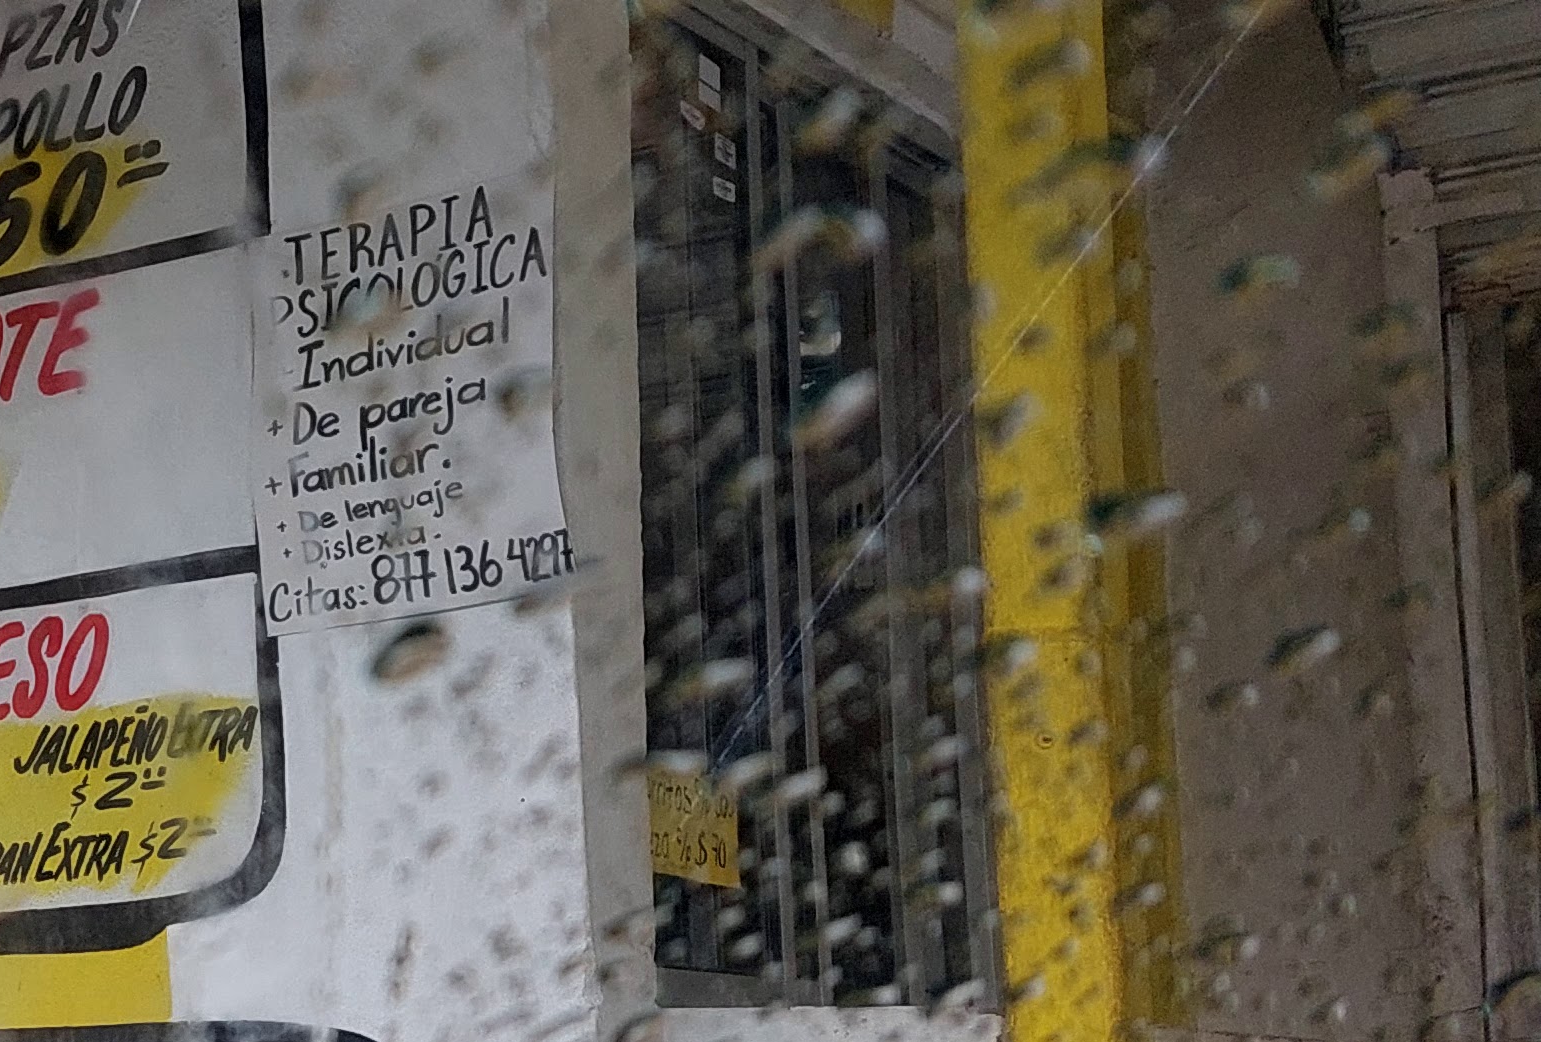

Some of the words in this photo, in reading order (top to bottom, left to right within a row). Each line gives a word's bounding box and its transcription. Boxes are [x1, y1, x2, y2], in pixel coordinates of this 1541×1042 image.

[284, 186, 493, 285] TERAPIA
[294, 296, 509, 391] Individual
[293, 402, 340, 446] De
[360, 377, 486, 451] pareja
[298, 510, 338, 532] De
[345, 480, 463, 528] lenguaje
[300, 526, 441, 564] Dislexa.
[269, 576, 368, 622] Citas:
[371, 549, 436, 605] 877
[444, 540, 502, 594] 136
